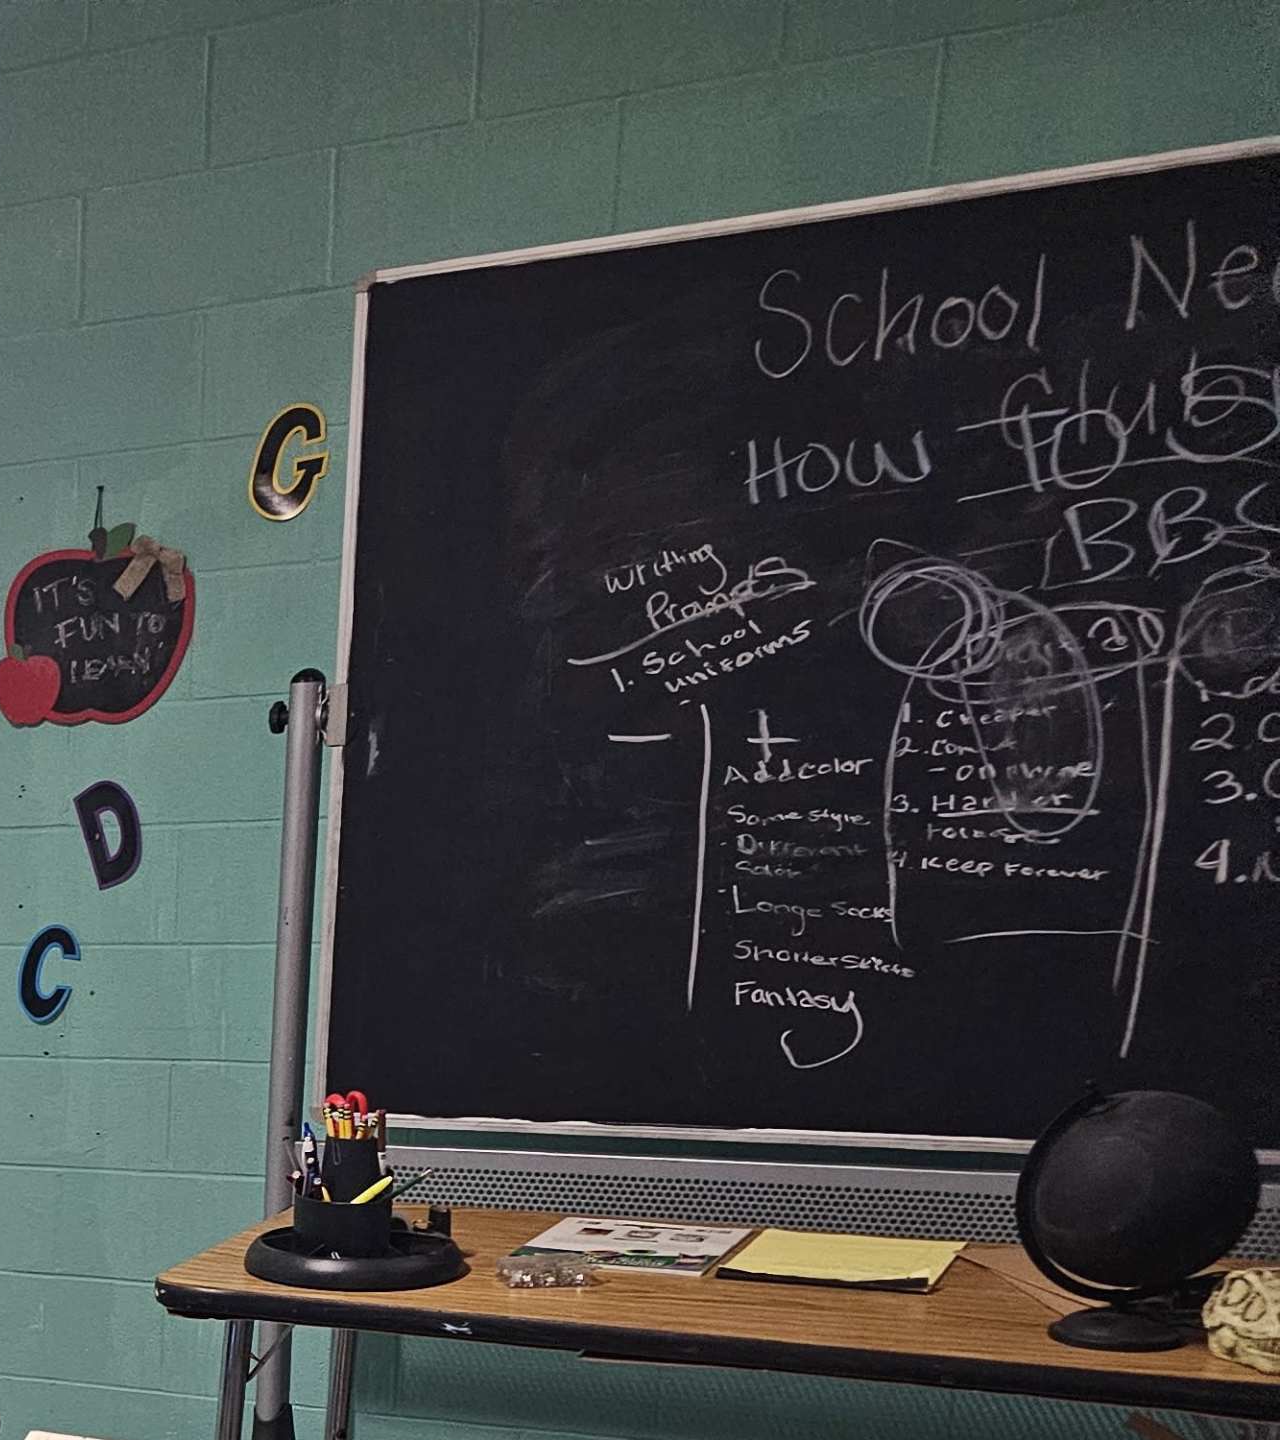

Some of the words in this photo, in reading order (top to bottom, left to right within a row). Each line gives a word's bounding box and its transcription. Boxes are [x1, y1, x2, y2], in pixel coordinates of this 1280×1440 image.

[754, 253, 1047, 379] School
[1124, 219, 1280, 331] Ne
[248, 402, 329, 522] G
[73, 780, 143, 890] D
[17, 923, 82, 1026] C
